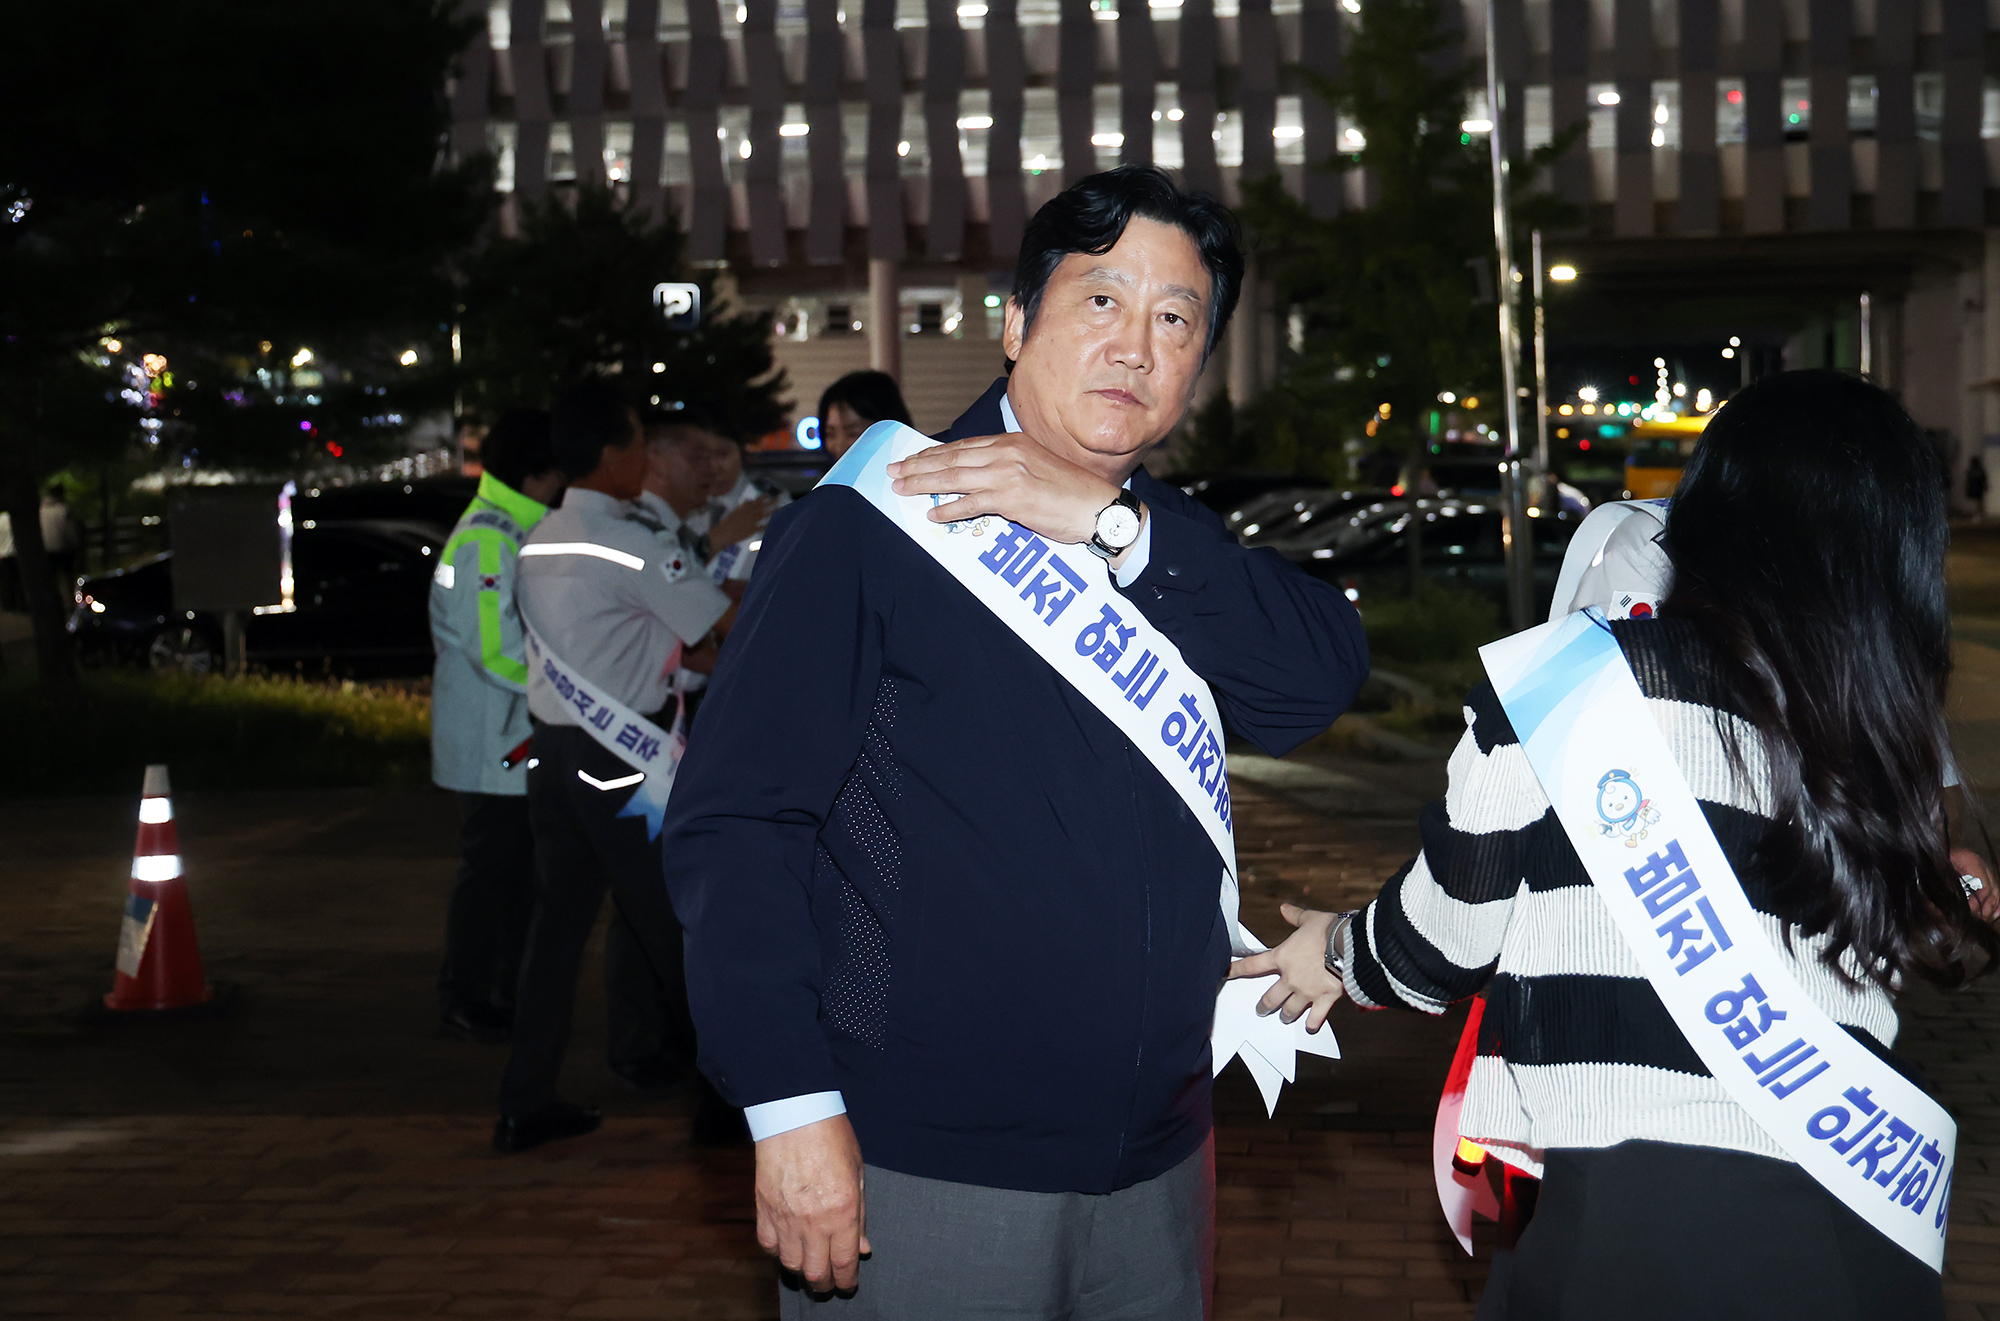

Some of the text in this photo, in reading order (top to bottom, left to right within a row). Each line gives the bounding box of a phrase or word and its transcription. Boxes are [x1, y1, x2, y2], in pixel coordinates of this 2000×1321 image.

[978, 522, 1089, 627] 범죄
[1075, 602, 1169, 711] 없는
[1622, 838, 1946, 1216] 범죄 없는 안전한
